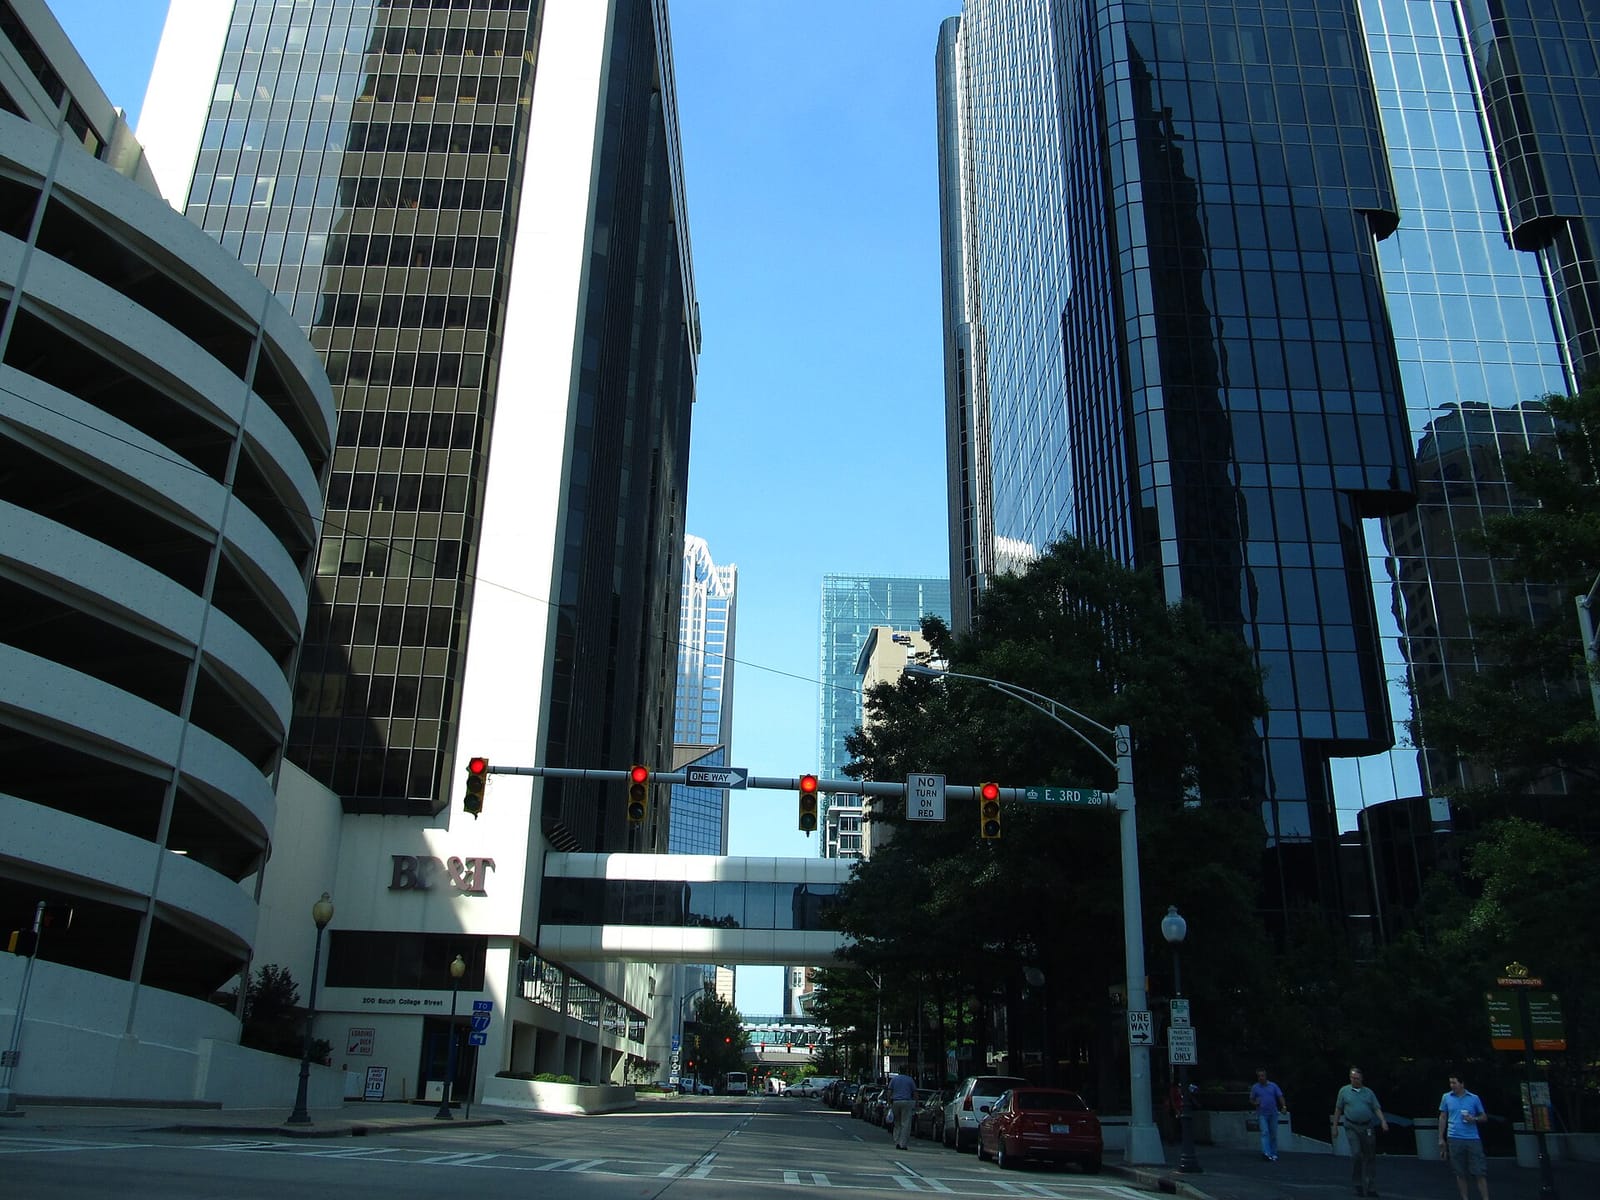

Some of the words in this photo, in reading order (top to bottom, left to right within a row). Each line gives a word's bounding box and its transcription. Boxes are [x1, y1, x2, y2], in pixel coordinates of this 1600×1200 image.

[692, 772, 710, 781] ONE
[711, 773, 729, 782] WAY
[918, 777, 935, 787] NO
[915, 789, 937, 797] TURN
[1045, 789, 1055, 801] E.
[1059, 790, 1081, 802] 3RD
[1092, 789, 1101, 798] ST
[920, 799, 932, 807] ON
[1087, 796, 1102, 805] 200
[918, 809, 934, 818] RED
[388, 855, 496, 898] BB&T
[399, 998, 421, 1006] College
[478, 1002, 488, 1010] TO
[474, 1016, 489, 1028] 77
[1130, 1013, 1149, 1022] ONE
[1130, 1022, 1150, 1031] WAY
[1174, 1052, 1192, 1061] ONLY
